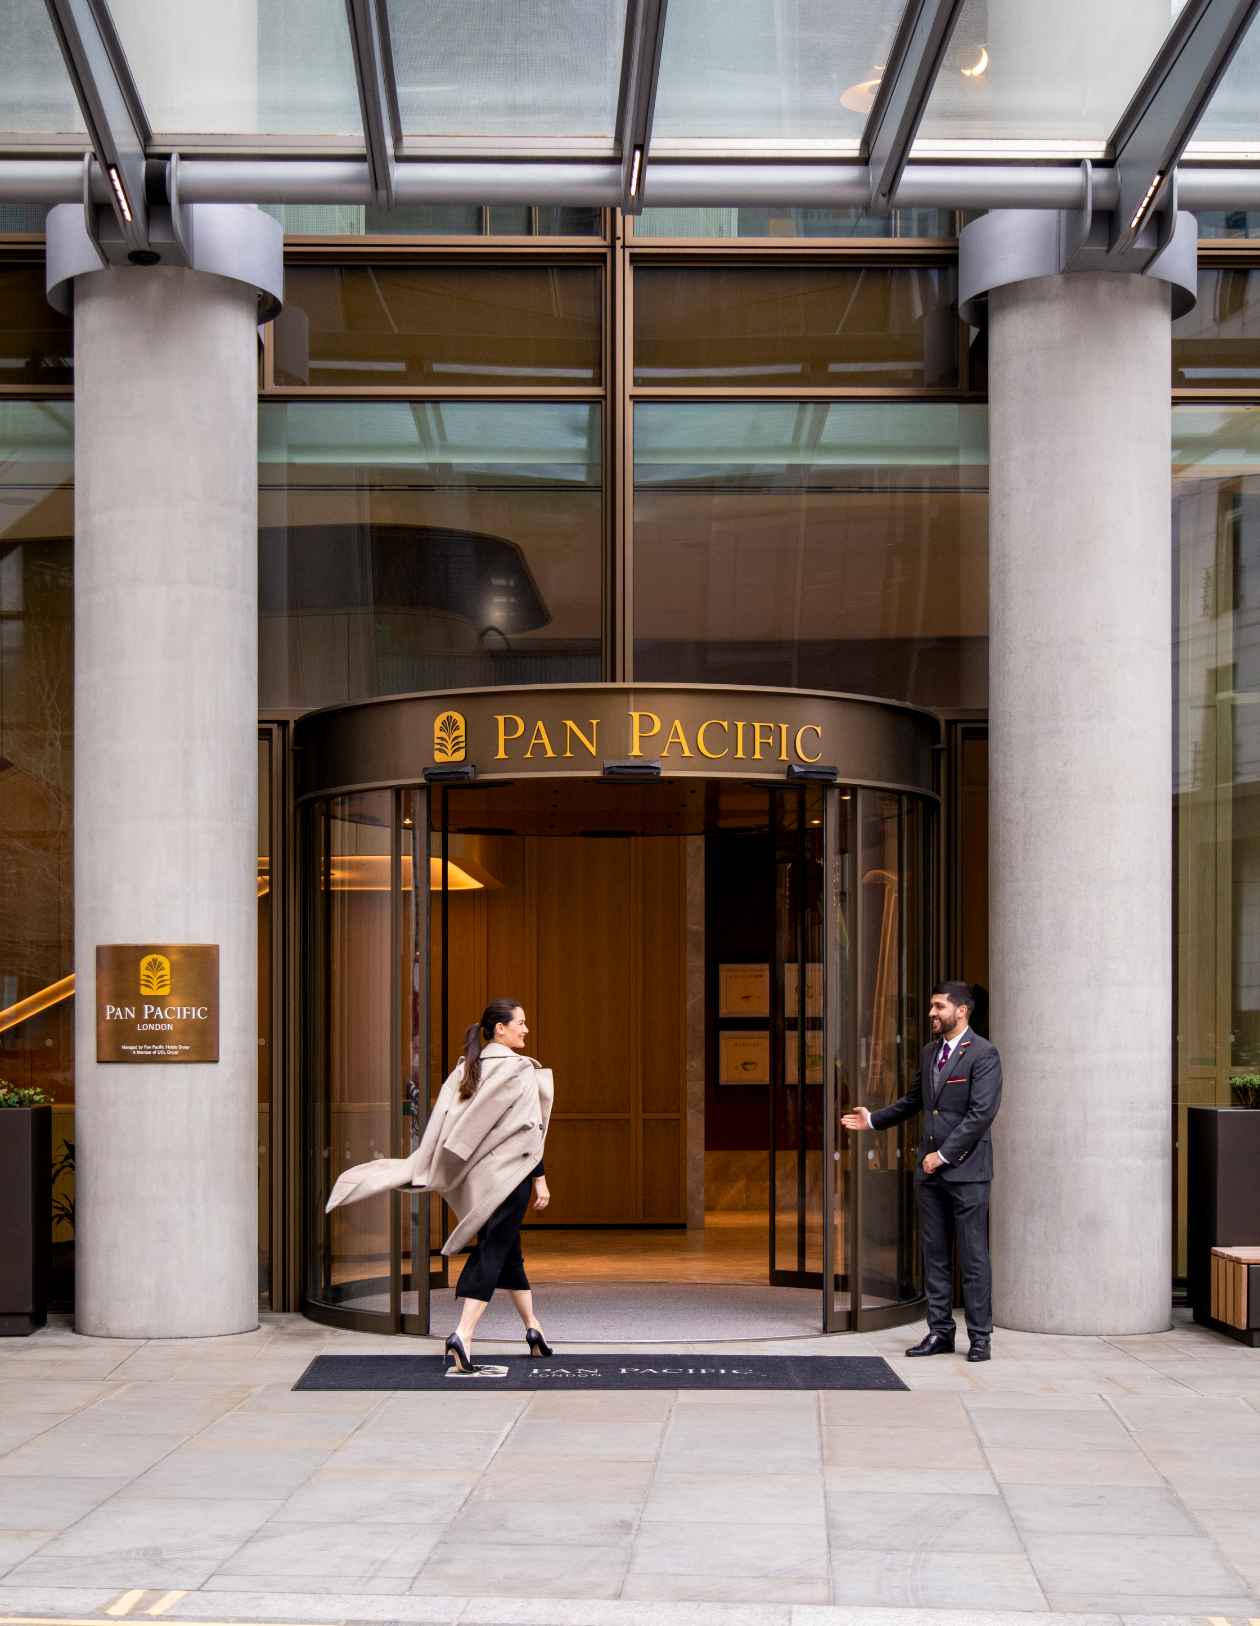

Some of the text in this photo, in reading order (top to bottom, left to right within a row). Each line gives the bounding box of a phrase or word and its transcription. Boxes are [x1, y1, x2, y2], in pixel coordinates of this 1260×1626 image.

[494, 711, 823, 763] PAN PACIFIC
[105, 1004, 208, 1020] PAN PACIFIC
[137, 1023, 174, 1031] LONDON
